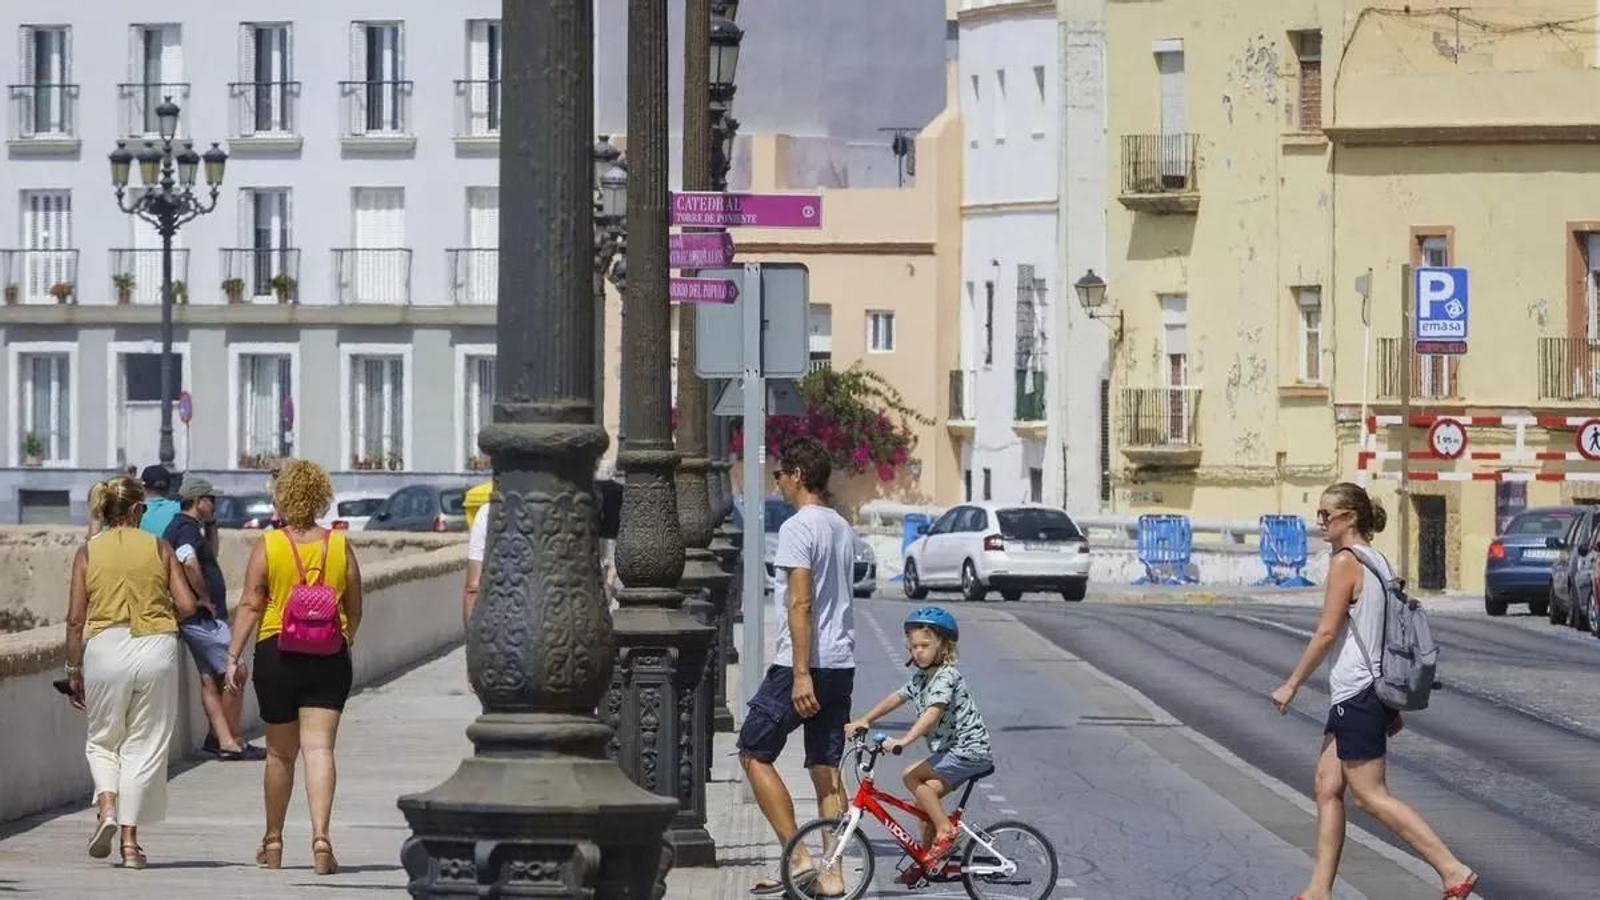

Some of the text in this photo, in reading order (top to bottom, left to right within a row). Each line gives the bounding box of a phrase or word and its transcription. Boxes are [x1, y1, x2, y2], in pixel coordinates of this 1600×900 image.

[676, 196, 742, 211] CATEDRAL
[676, 212, 758, 224] TORRE DE PONIENTE
[1420, 271, 1455, 318] P
[1422, 322, 1461, 331] emasa
